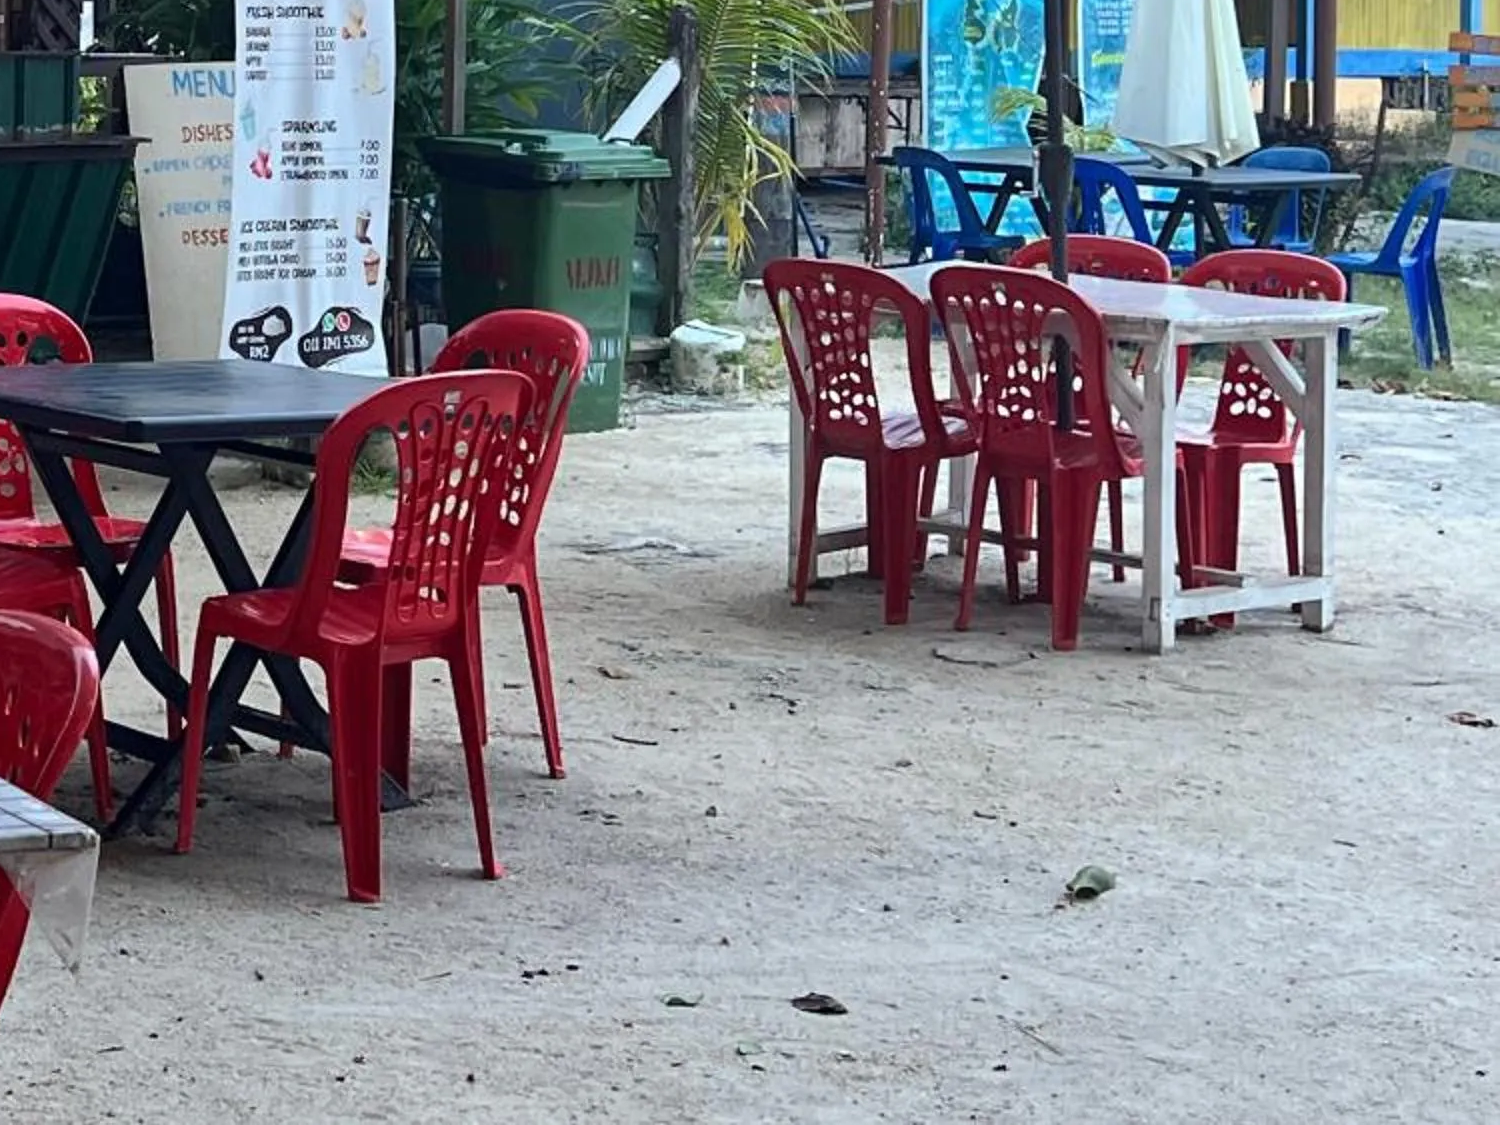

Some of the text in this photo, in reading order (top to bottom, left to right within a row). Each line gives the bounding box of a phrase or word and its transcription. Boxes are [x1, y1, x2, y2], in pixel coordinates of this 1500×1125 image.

[276, 6, 325, 19] SMOOTHIE
[172, 70, 236, 98] MENU
[181, 124, 234, 144] DISHES
[240, 220, 253, 233] ICE
[255, 219, 287, 232] CREAM
[181, 230, 229, 247] DESSE
[343, 335, 369, 349] 5356
